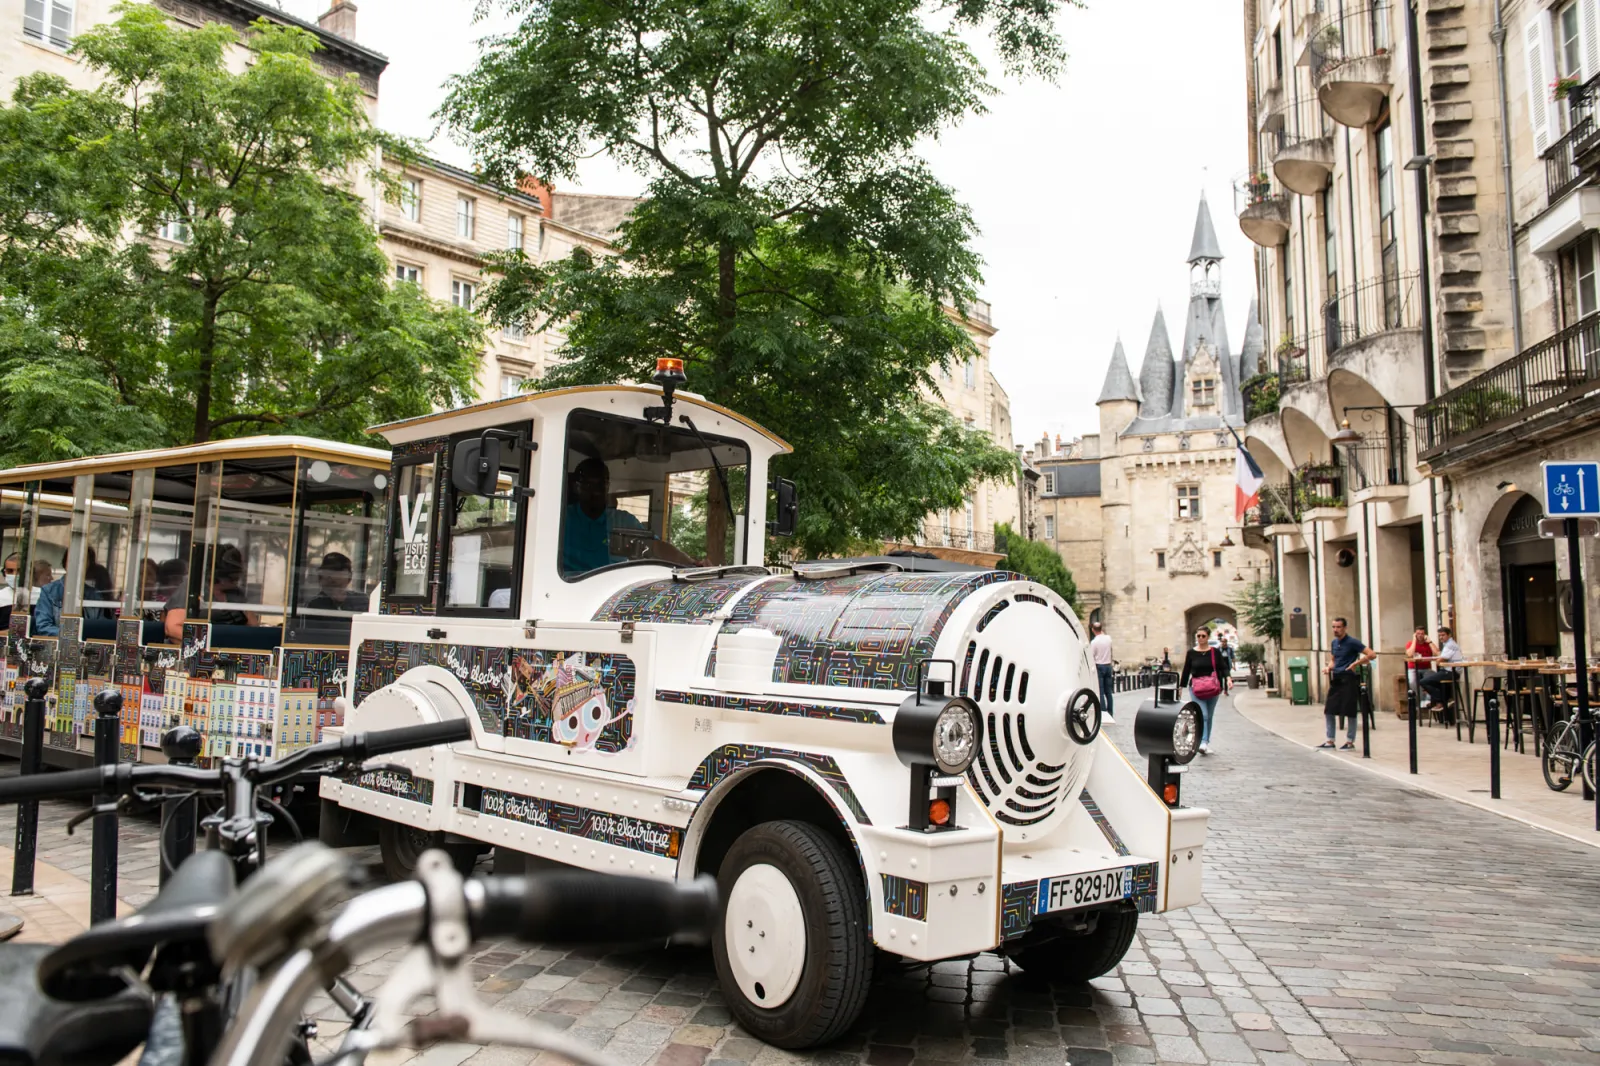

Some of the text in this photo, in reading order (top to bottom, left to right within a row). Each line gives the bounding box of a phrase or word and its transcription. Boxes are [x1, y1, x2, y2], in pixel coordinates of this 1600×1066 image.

[404, 543, 428, 555] VISITE
[404, 554, 427, 570] ECO
[484, 794, 549, 826] 100% électrique
[591, 815, 670, 853] 100% électrique
[1049, 871, 1123, 909] FF-829-DX
